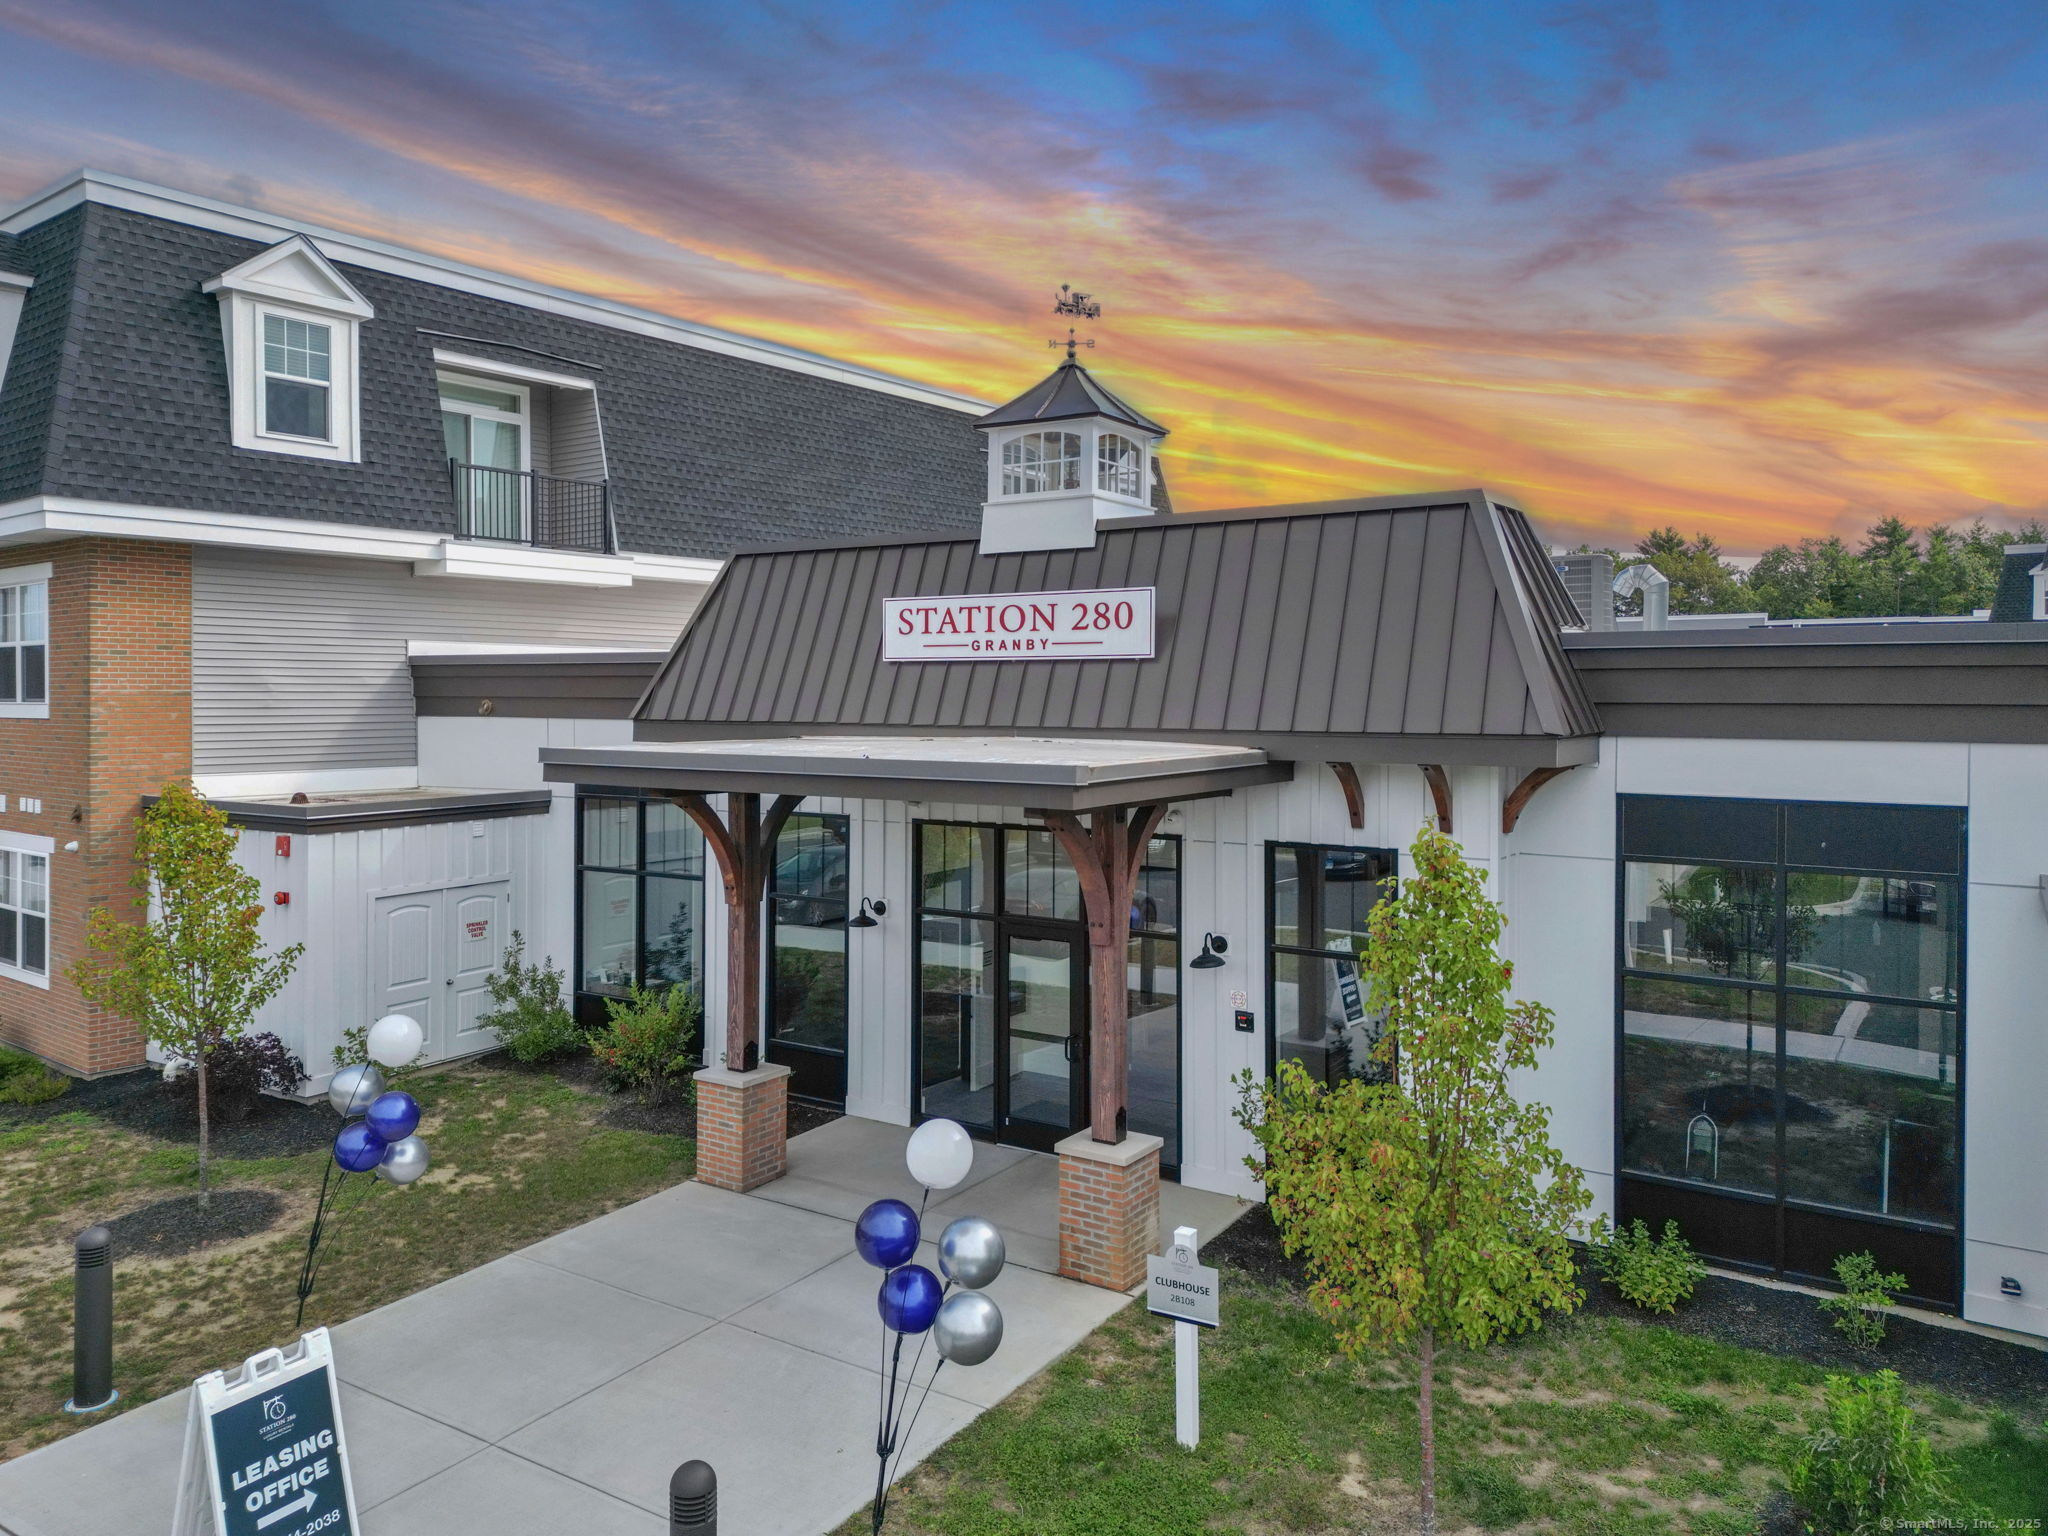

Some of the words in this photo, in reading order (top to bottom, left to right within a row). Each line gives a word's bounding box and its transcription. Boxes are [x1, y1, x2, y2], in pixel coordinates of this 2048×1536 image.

[899, 603, 1058, 635] STATION
[1071, 601, 1134, 631] 280
[971, 638, 1049, 651] GRANBY
[466, 920, 488, 928] SPRINKLER
[1155, 1276, 1210, 1296] CLUBHOUSE
[1170, 1293, 1195, 1307] 2B108
[259, 1418, 286, 1435] STATION
[286, 1414, 297, 1422] 280
[232, 1429, 333, 1491] LEASING
[245, 1457, 330, 1513] OFFICE
